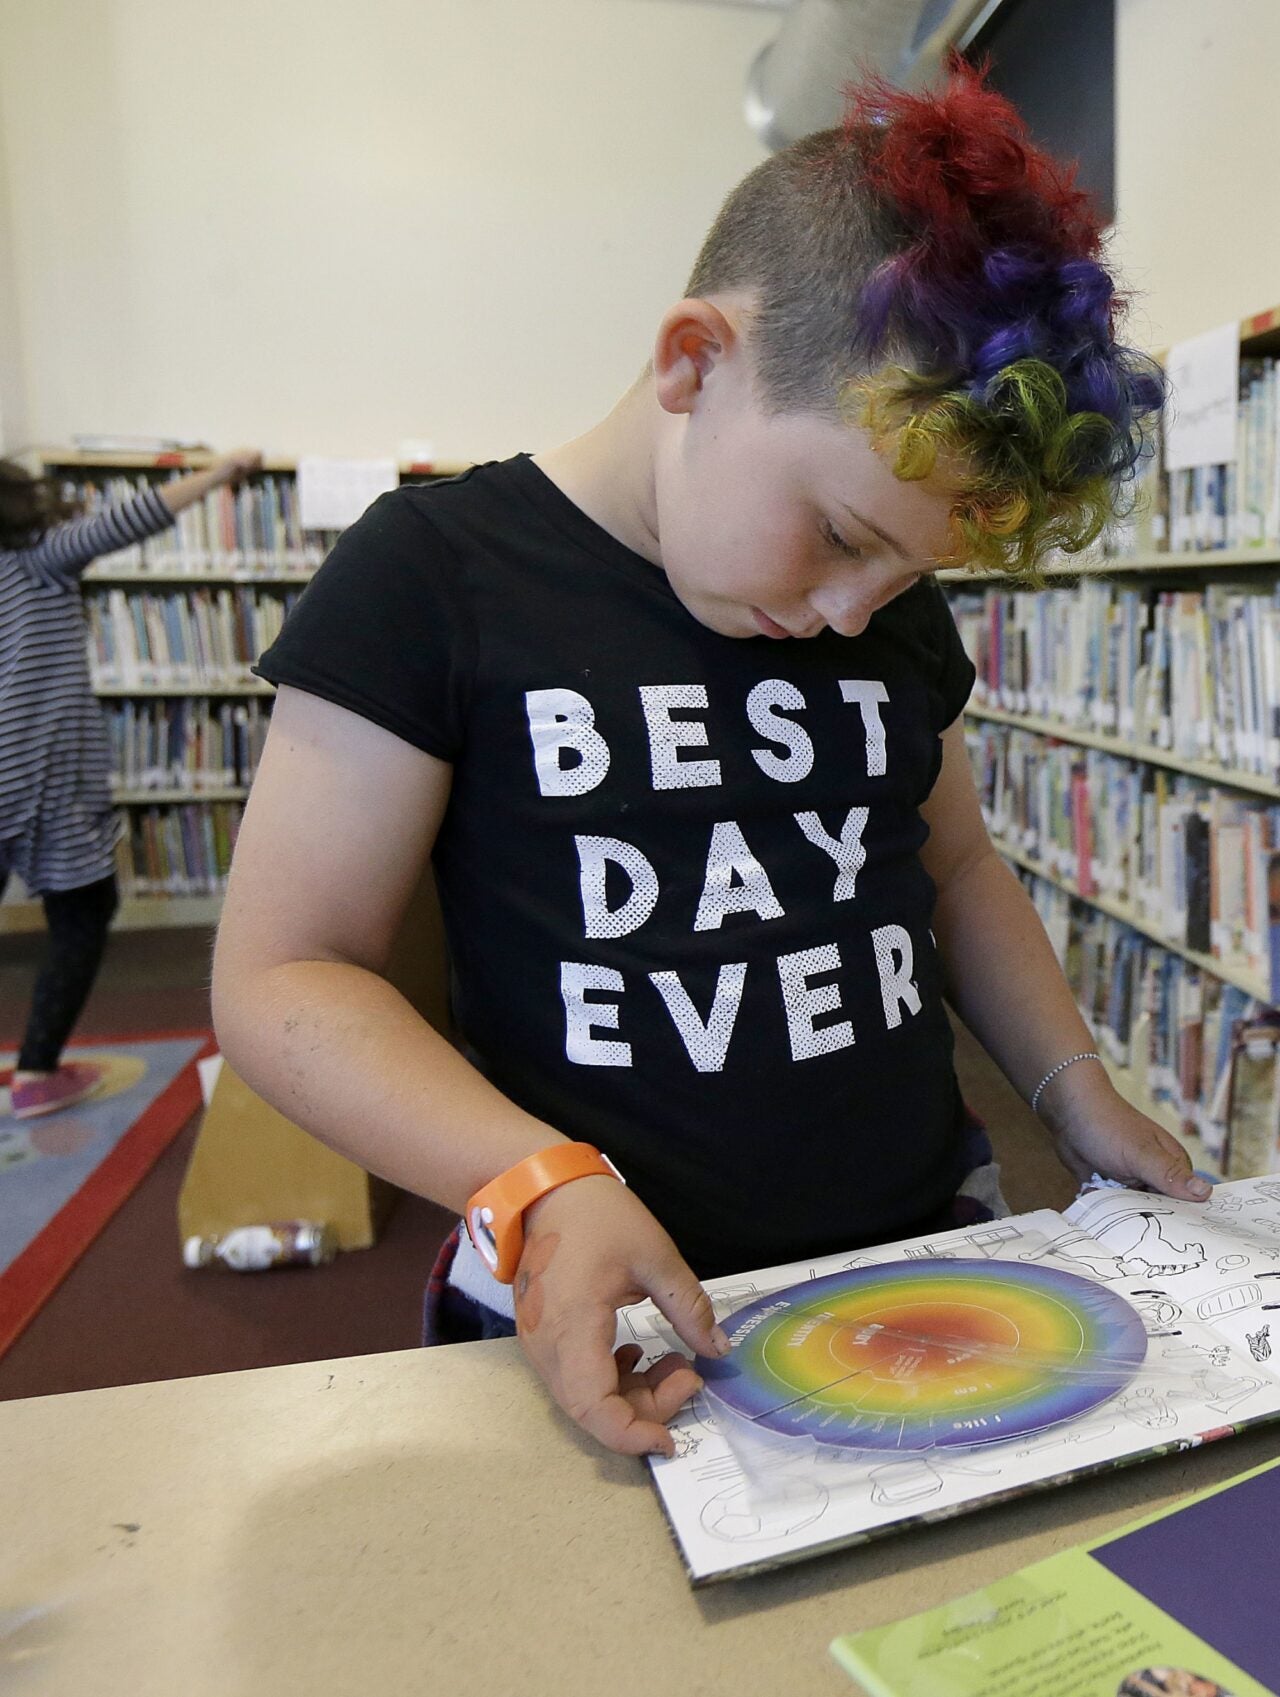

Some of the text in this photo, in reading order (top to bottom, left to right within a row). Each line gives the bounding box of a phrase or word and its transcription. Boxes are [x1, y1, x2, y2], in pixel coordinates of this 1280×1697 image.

[524, 678, 891, 797] BEST
[573, 806, 870, 939] DAY
[560, 923, 922, 1073] EVER
[951, 1415, 988, 1430] like
